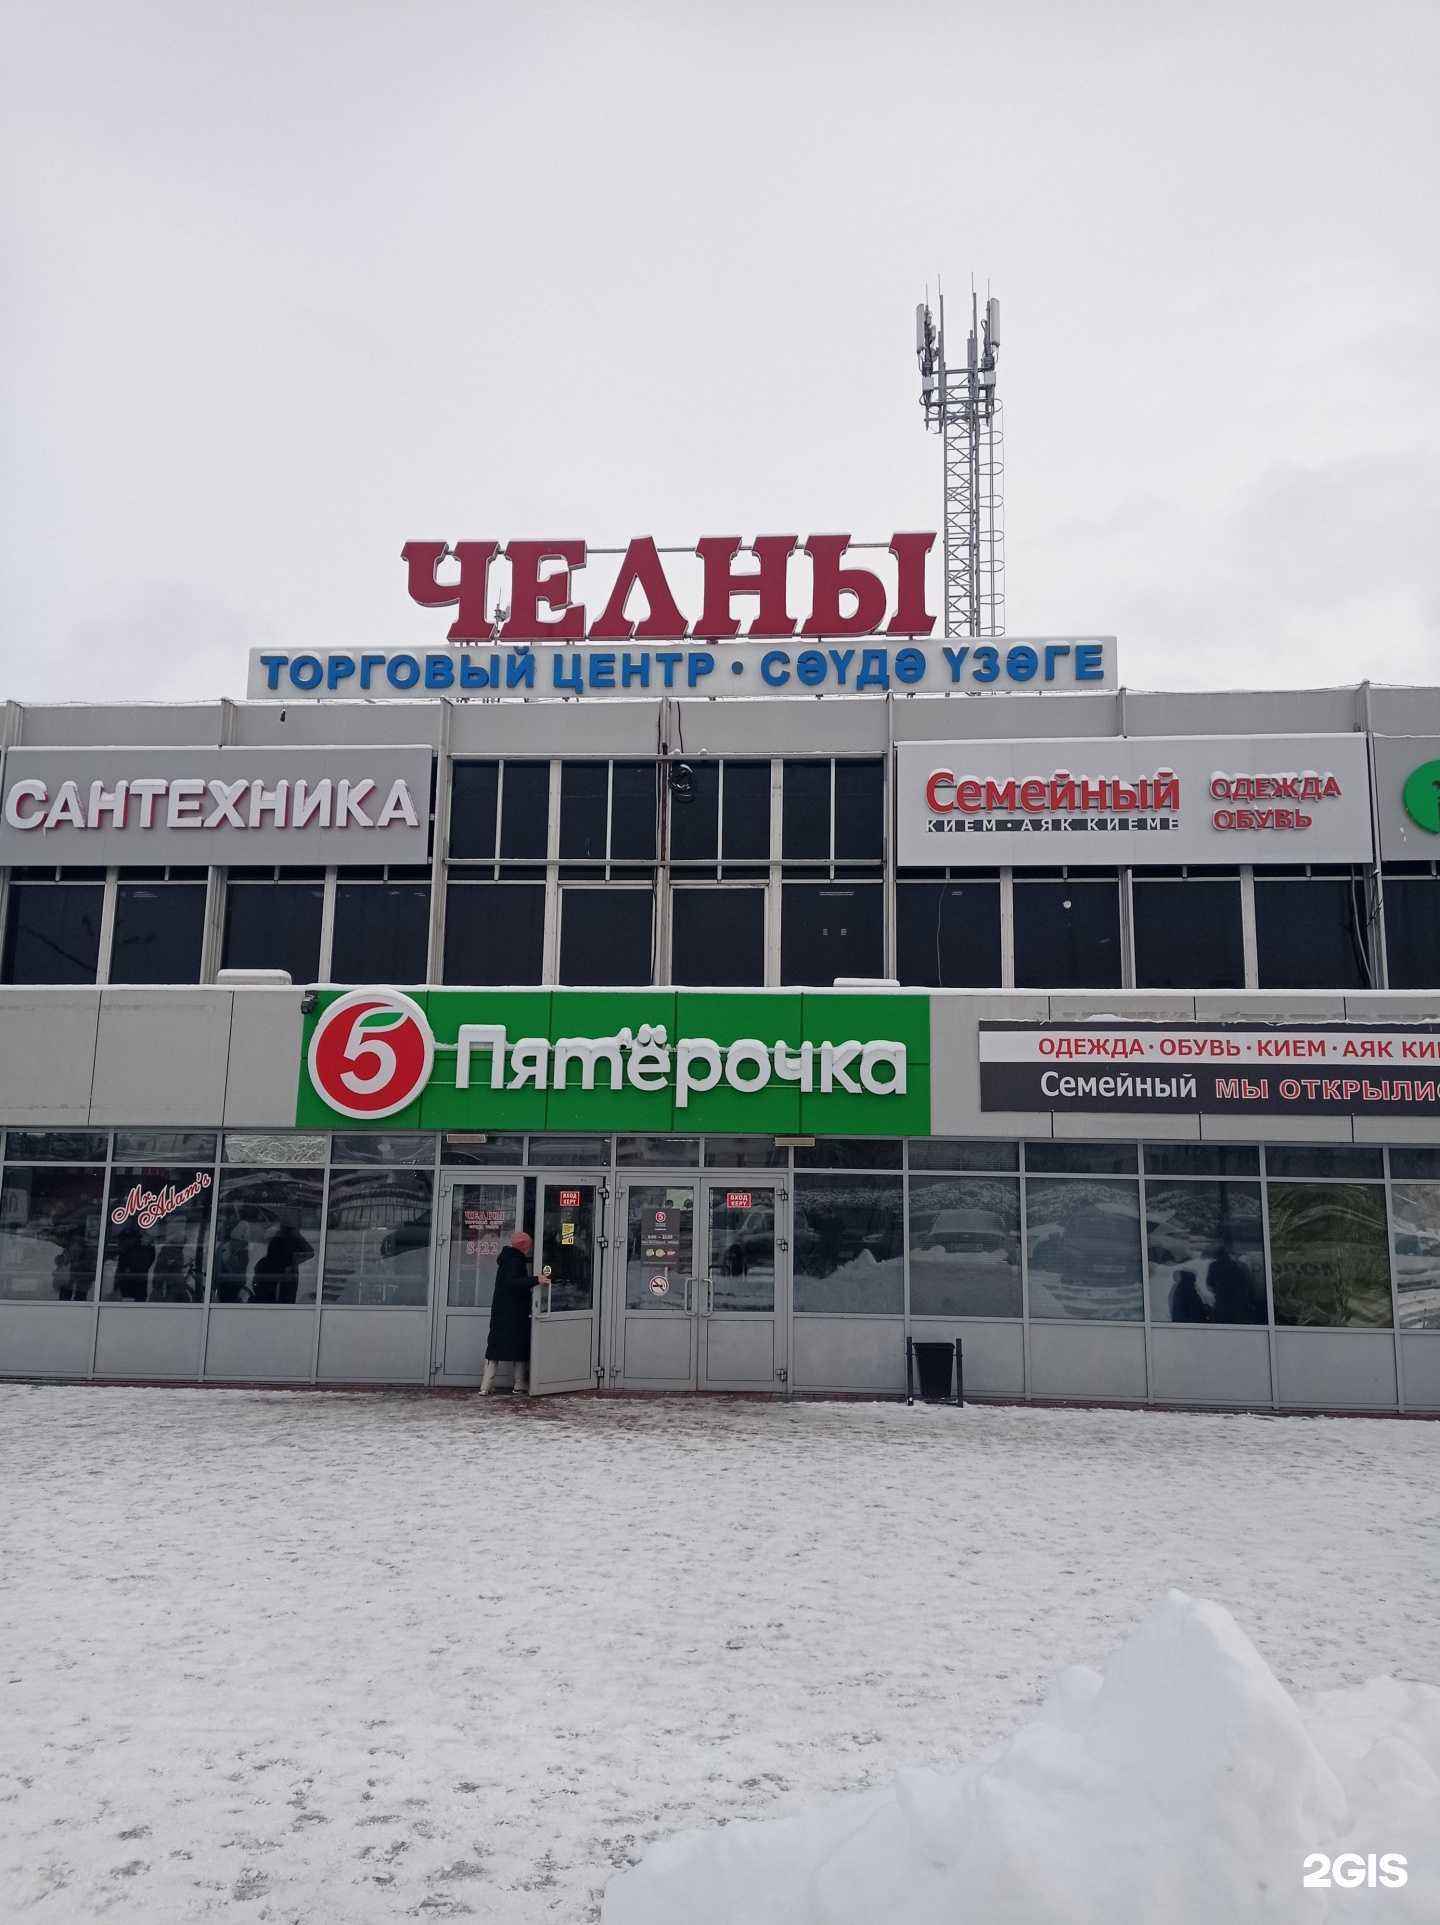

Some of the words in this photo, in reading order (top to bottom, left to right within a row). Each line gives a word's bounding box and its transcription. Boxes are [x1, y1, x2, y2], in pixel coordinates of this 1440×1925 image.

[401, 531, 937, 641] ЧЕЛНЫ
[260, 645, 536, 690] ТОРГОВЫЙ
[553, 652, 715, 694] ЦЕНТР
[5, 777, 420, 830] САНТЕХНИКА
[926, 768, 1181, 813] Семейный
[1209, 774, 1342, 802] ОДЕЖДА
[927, 819, 996, 832] КИЕМ
[1021, 818, 1073, 832] АЯК
[1087, 817, 1181, 831] КИЕМЕ
[1212, 807, 1312, 831] ОБУВЬ
[456, 1023, 906, 1107] Пятёрочка
[1038, 1038, 1145, 1058] ОДЕЖДА
[1160, 1039, 1241, 1057] ОБУВЬ
[1257, 1039, 1326, 1057] КИЕМ
[1342, 1040, 1393, 1058] АЯК
[1041, 1071, 1197, 1098] Семейный
[1216, 1078, 1268, 1099] МЫ
[112, 1184, 157, 1224] Mr.
[138, 1172, 211, 1229] Adam's
